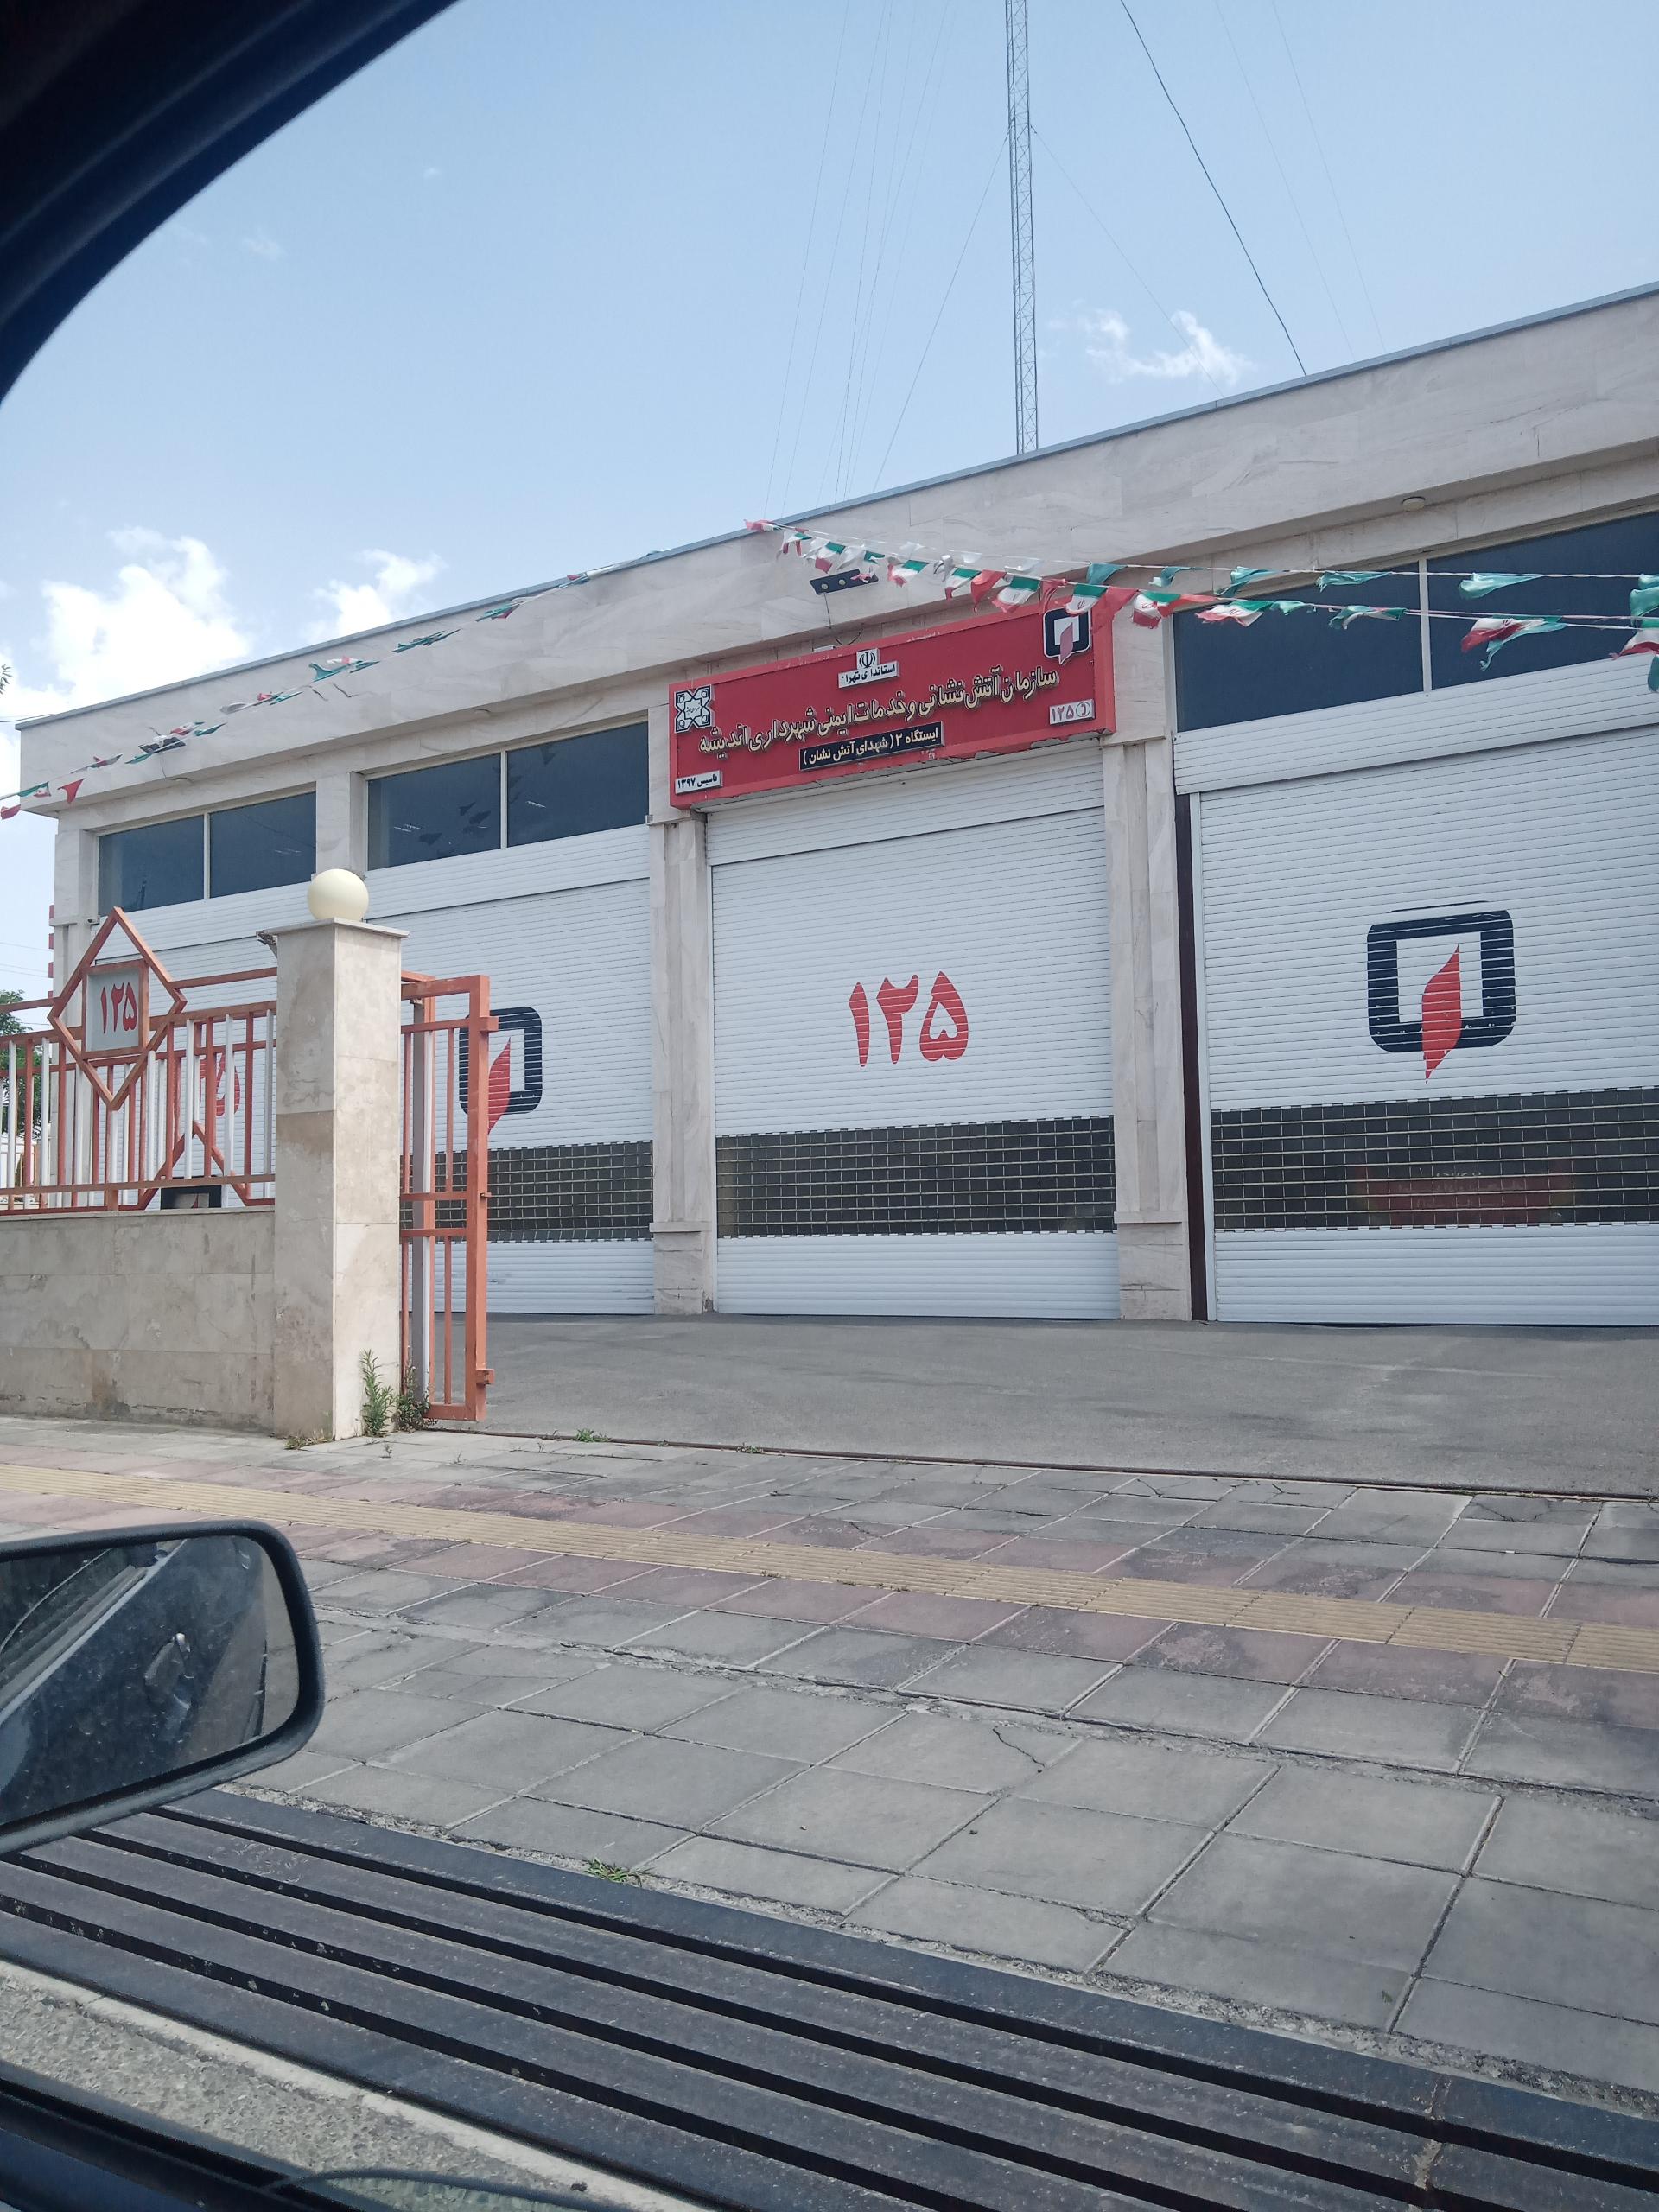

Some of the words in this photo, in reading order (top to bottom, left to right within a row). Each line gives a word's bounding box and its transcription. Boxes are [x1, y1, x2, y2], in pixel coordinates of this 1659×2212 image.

[918, 679, 964, 717] نشانی
[964, 664, 1001, 709] آتش
[1001, 666, 1059, 702] سازمان
[817, 704, 853, 736] ایمنی
[854, 690, 906, 722] خدمات
[906, 700, 916, 722] و
[1051, 704, 1075, 722] ۱۲۵
[698, 724, 748, 760] اندیشه
[748, 707, 817, 751] شهرداری
[905, 727, 938, 744] ایستگاه
[832, 740, 855, 762] آتش
[677, 777, 696, 789] ۱۳۹۷
[100, 981, 138, 1034] ۱۲۵
[848, 970, 969, 1068] ۱۲۵
